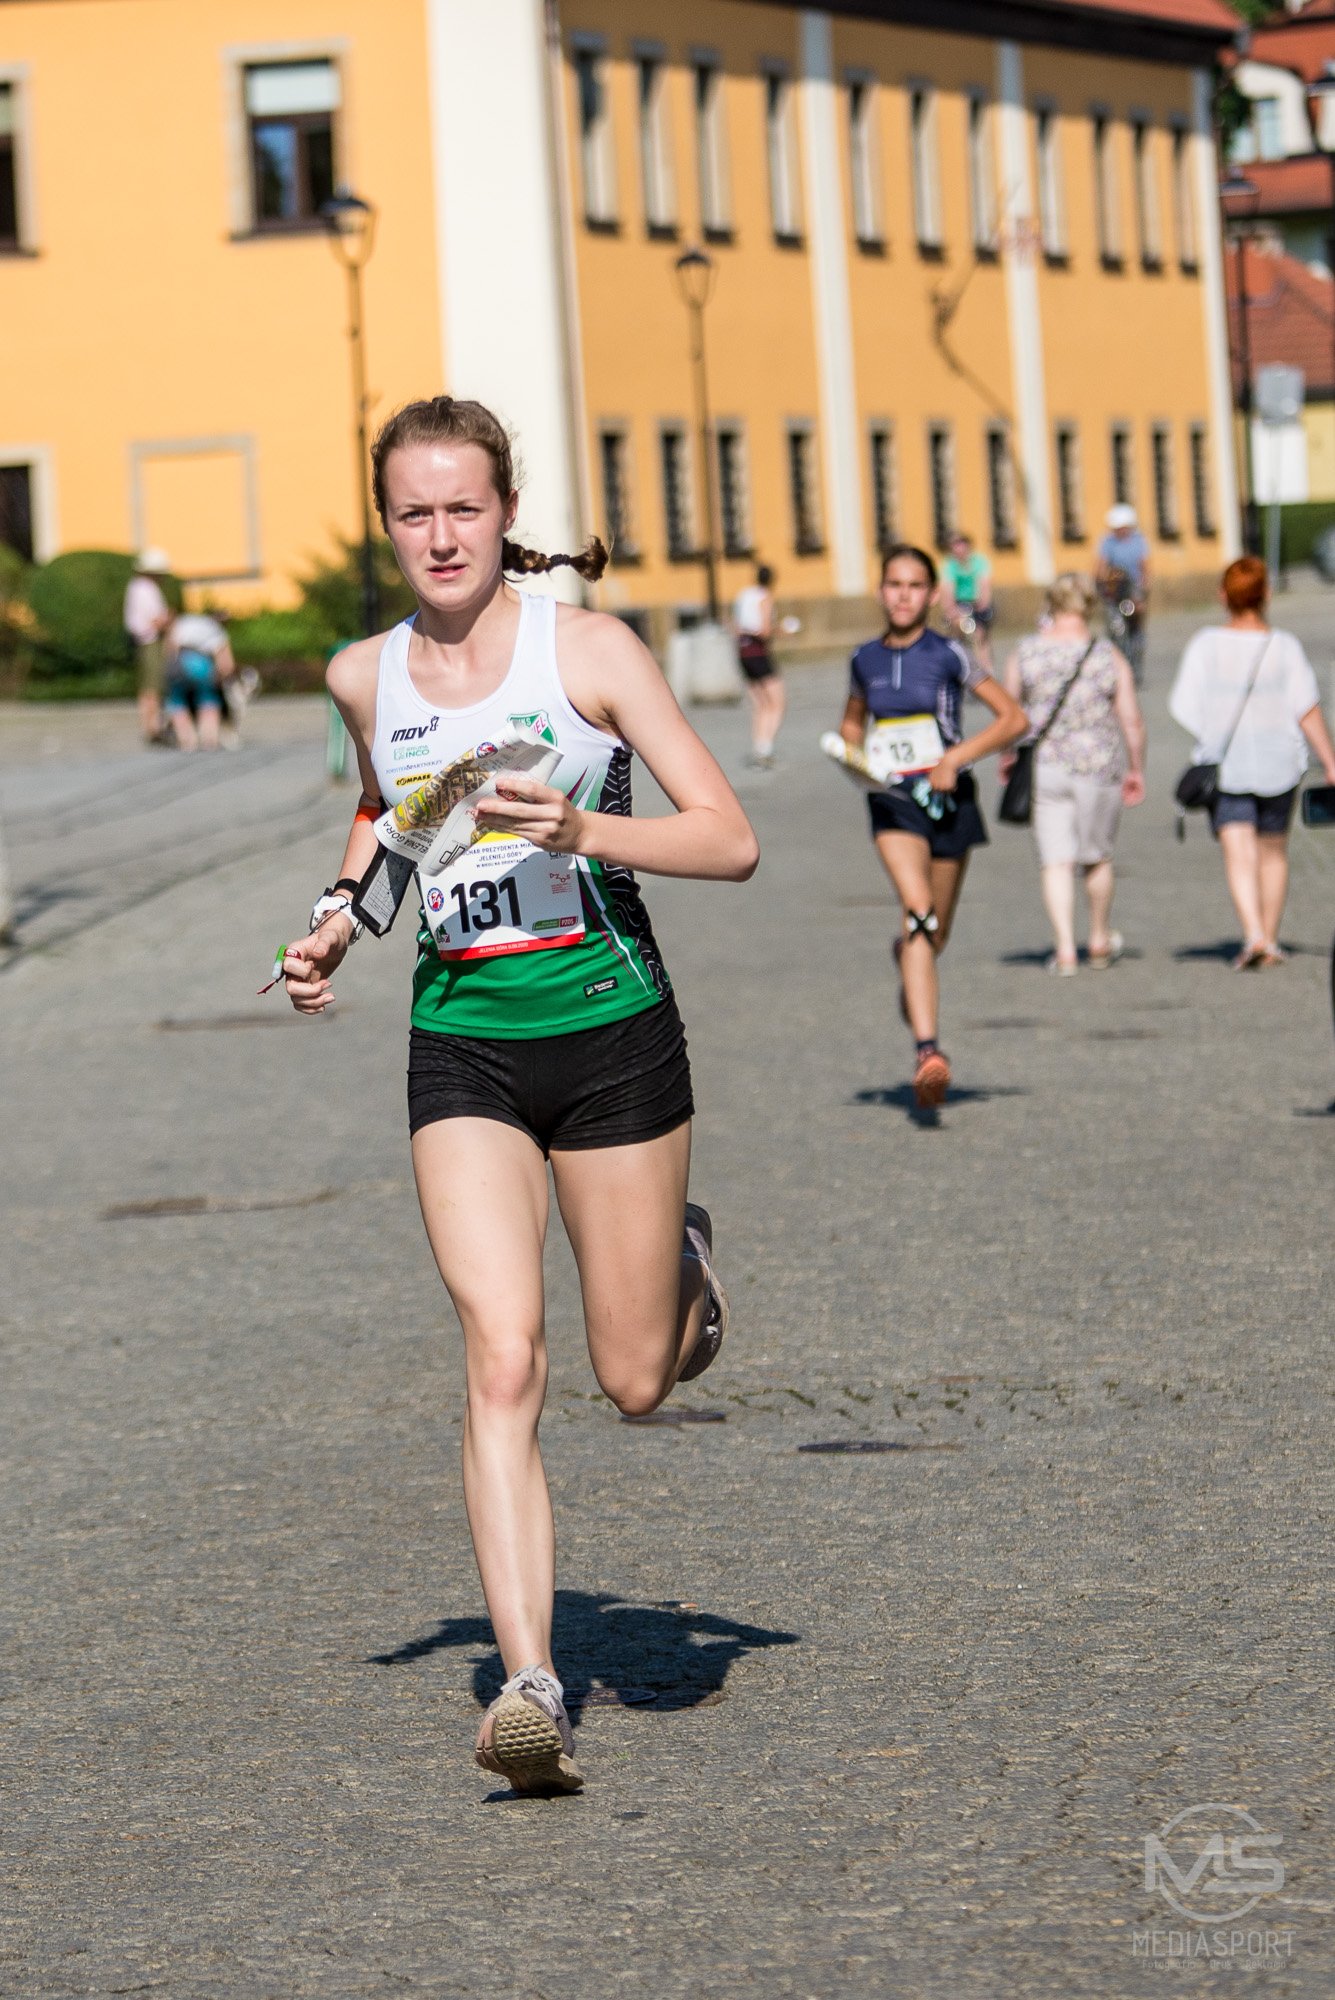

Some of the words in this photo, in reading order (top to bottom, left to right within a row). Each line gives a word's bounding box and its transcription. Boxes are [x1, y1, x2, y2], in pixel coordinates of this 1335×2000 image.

[405, 750, 429, 758] INCO
[889, 741, 916, 764] 13
[481, 844, 519, 854] PREZYDENTA
[478, 853, 506, 862] JELENIEJ
[450, 876, 523, 934] 131
